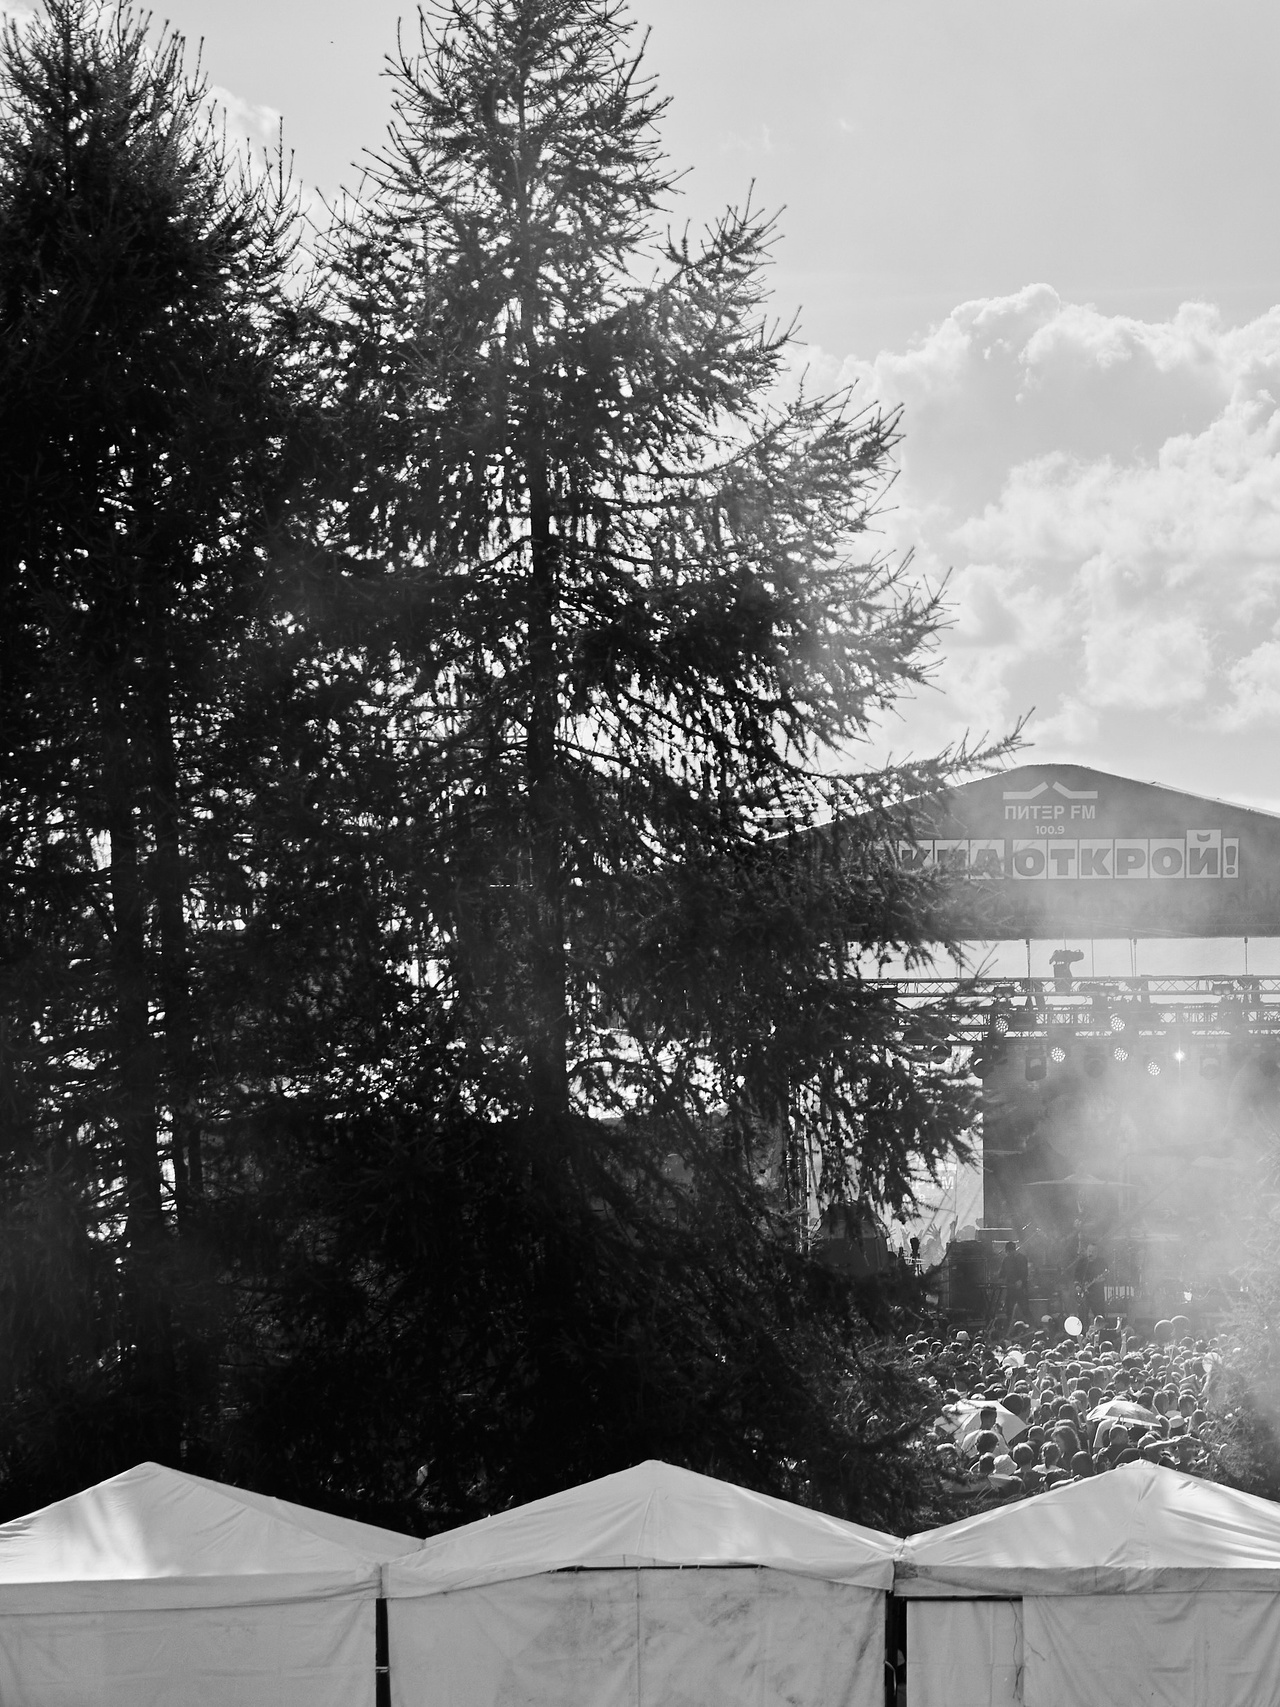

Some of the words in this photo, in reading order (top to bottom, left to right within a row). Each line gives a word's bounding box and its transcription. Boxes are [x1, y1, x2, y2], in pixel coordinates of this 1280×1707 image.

[1004, 805, 1066, 820] ПИТЕР
[1070, 804, 1096, 820] FM
[1034, 825, 1066, 835] 100.9
[1013, 832, 1237, 877] ОТКРОЙ!
